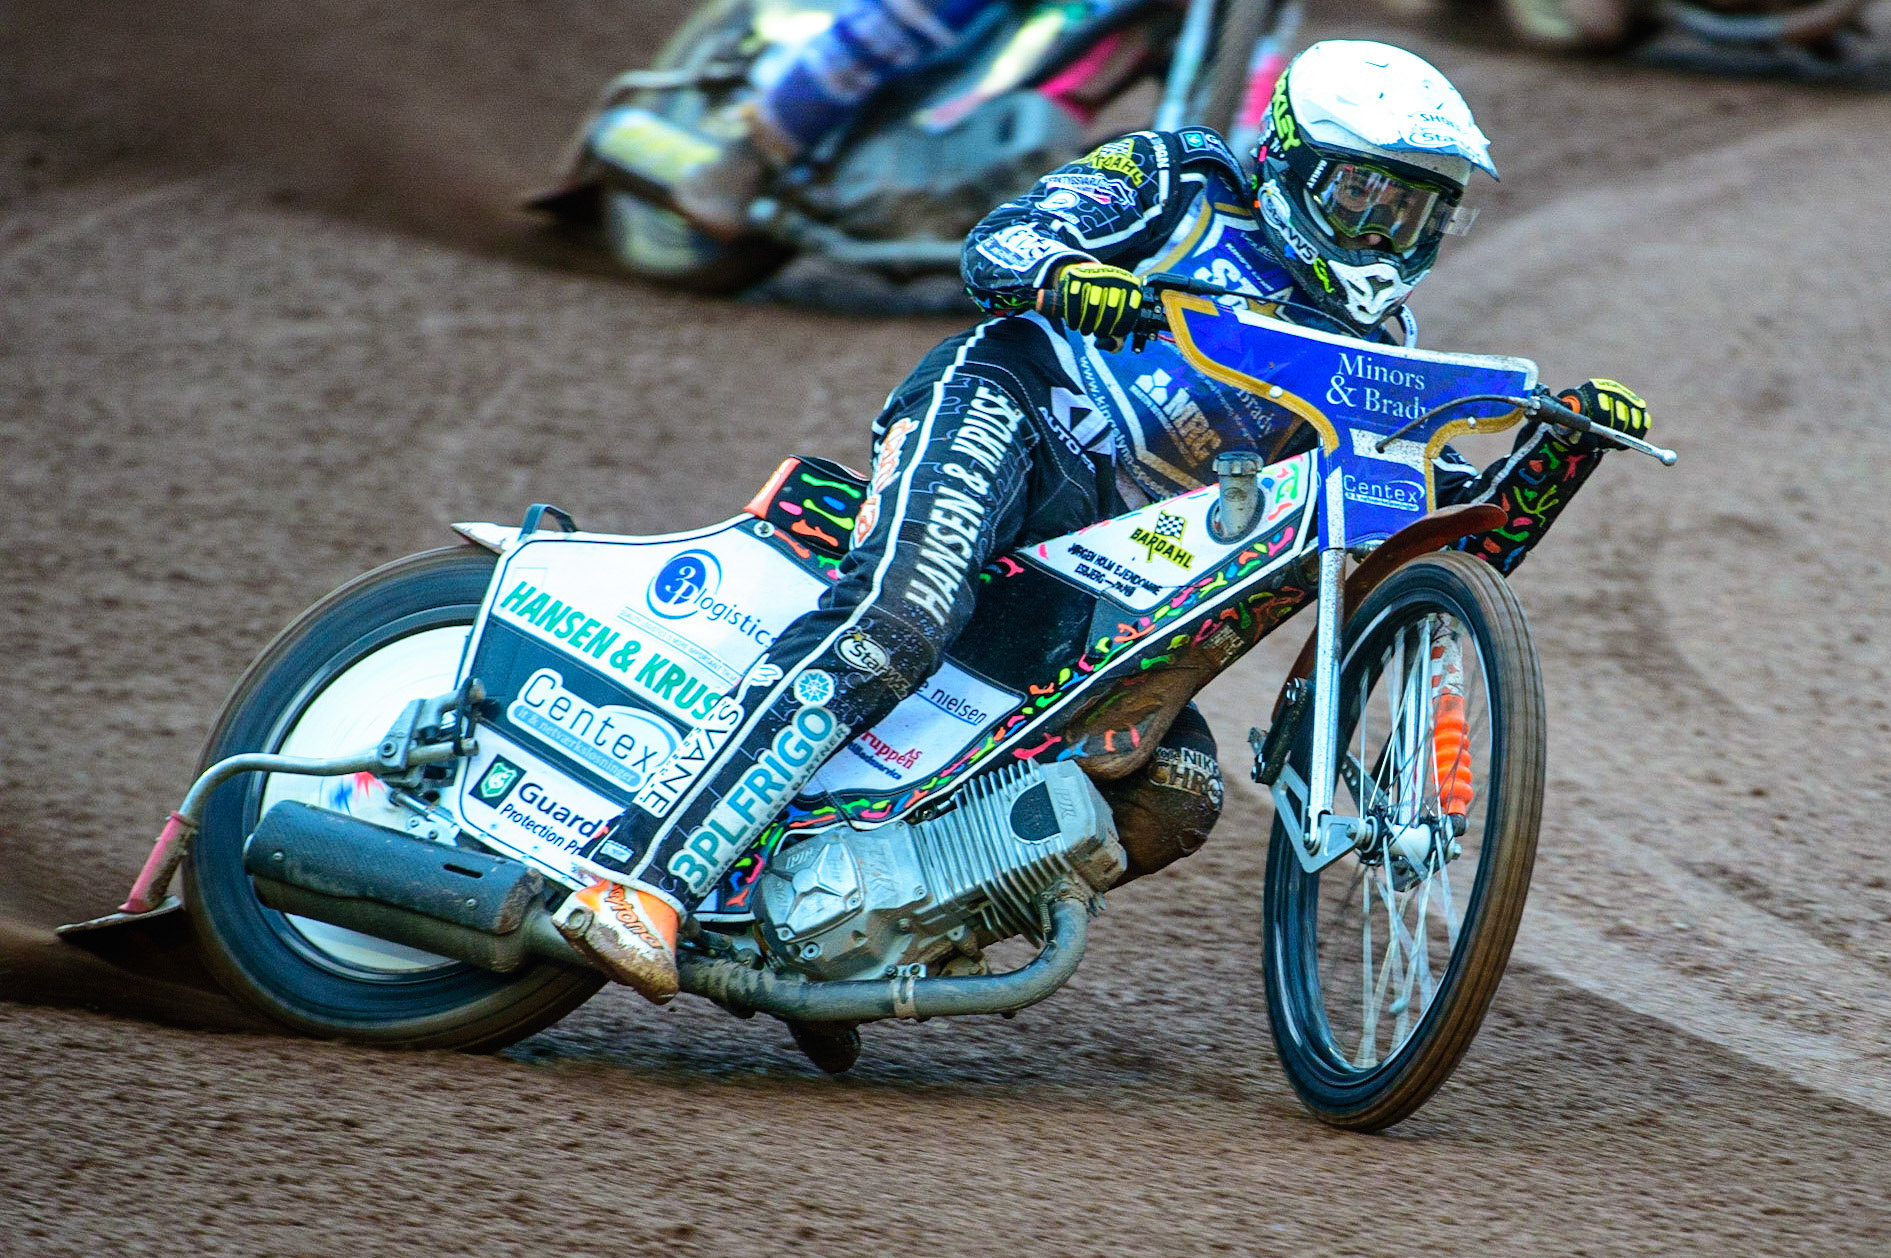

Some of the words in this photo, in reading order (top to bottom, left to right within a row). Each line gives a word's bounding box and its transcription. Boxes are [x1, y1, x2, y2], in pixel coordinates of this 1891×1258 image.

[1326, 375, 1357, 408] &
[1335, 352, 1426, 391] Minors
[952, 386, 1025, 476] KRUSE
[1038, 406, 1081, 456] AUTO
[947, 457, 992, 495] &
[1343, 474, 1418, 503] Centex
[906, 485, 984, 626] HANSEN
[1130, 527, 1195, 569] BARDAHL
[501, 581, 613, 661] HANSEN
[609, 640, 642, 674] &
[524, 674, 659, 773] Centex
[643, 699, 739, 814] SVANE
[857, 729, 916, 773] ruppen
[905, 746, 923, 762] AS
[517, 781, 603, 841] Guard
[673, 709, 833, 888] 3PLFRIGO
[501, 803, 565, 847] Protection
[605, 882, 665, 949] aytona
